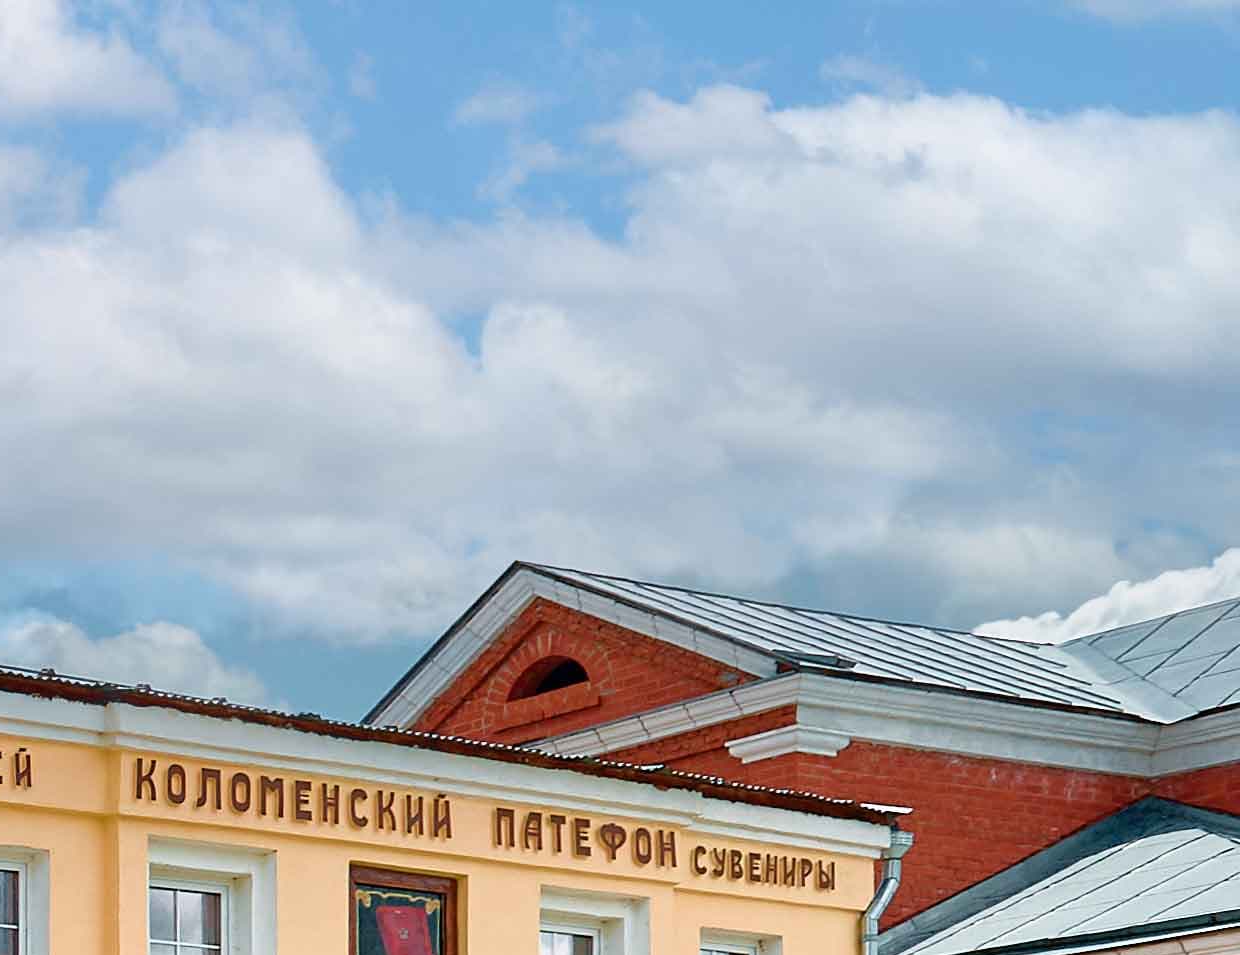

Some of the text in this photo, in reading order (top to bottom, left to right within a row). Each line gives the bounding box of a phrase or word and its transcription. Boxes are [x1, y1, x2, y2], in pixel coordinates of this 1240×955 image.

[134, 757, 453, 839] КОЛОМЕНСКИЙ
[493, 807, 678, 867] ПАТЕФОН
[691, 846, 837, 890] СУВЕНИРЫ
